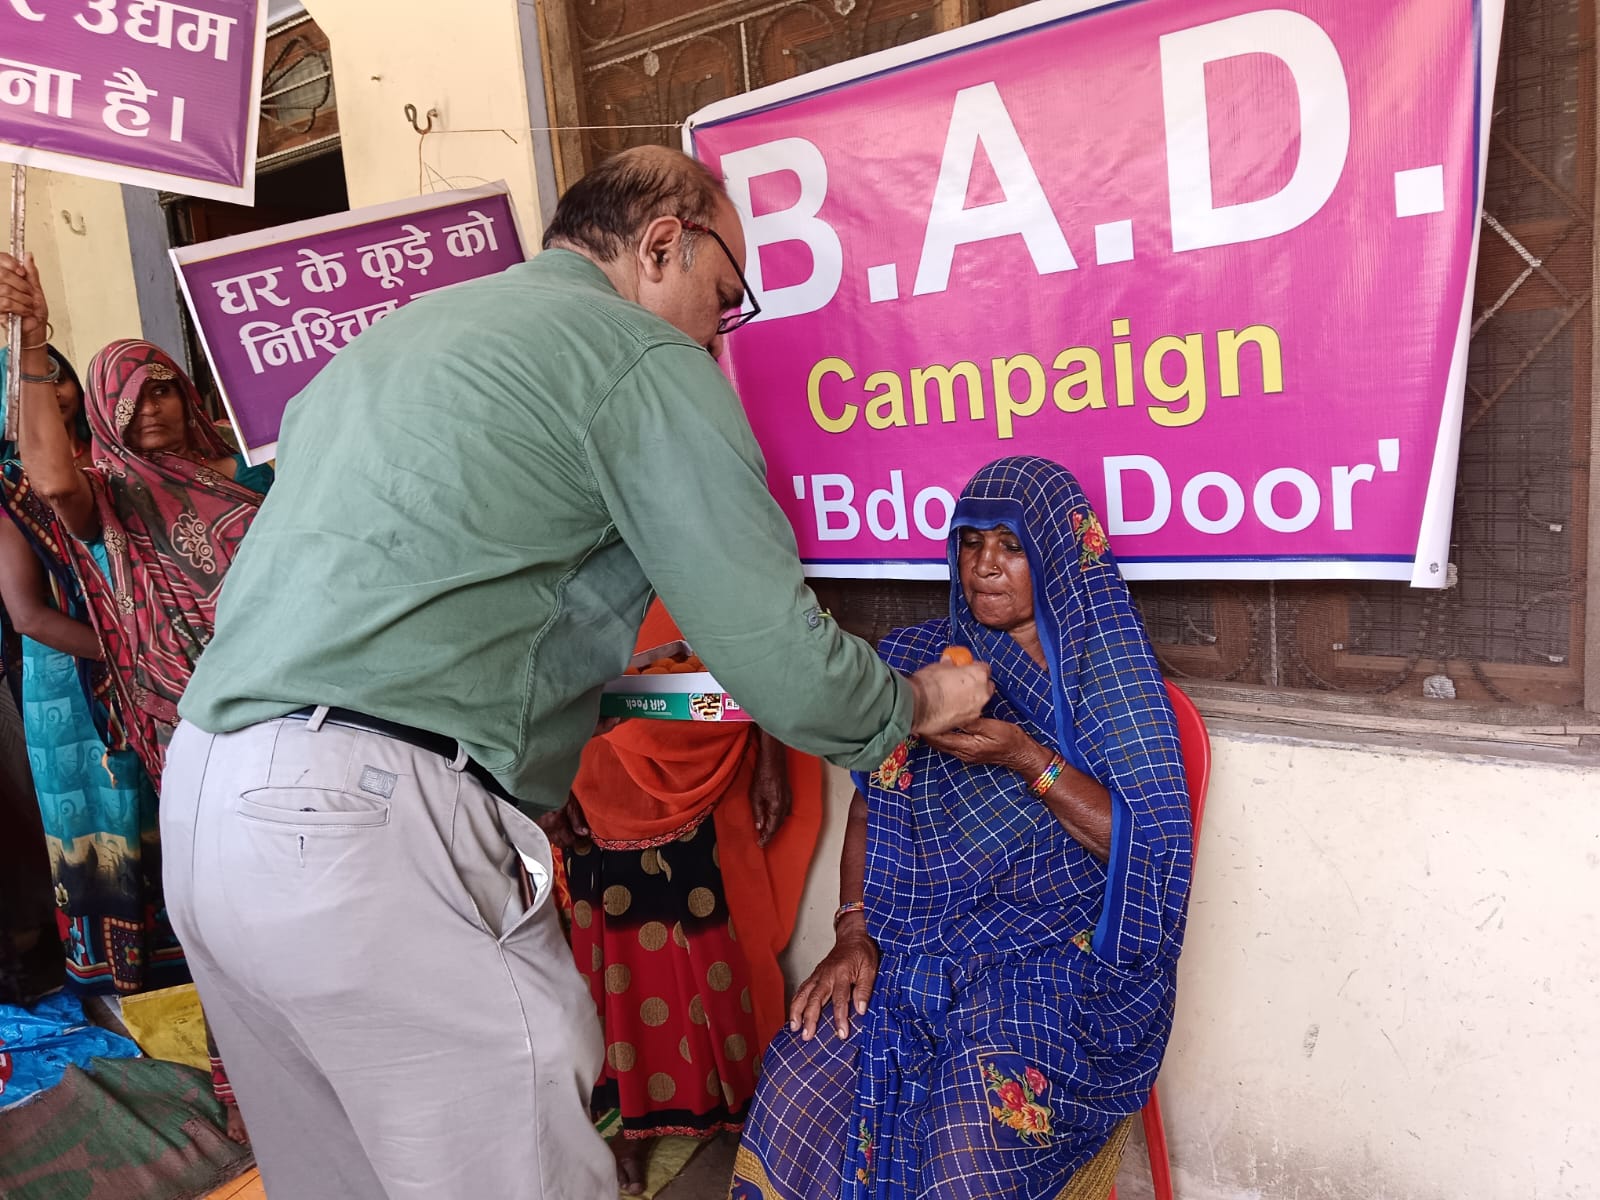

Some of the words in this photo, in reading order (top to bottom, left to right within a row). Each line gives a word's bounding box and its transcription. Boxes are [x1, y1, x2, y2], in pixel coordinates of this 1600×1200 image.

[719, 9, 1445, 323] B.A.D.
[211, 266, 290, 316] घर
[296, 249, 348, 293] के
[356, 225, 434, 289] कूड़े
[442, 211, 499, 258] को
[806, 319, 1285, 440] Campaign
[1102, 438, 1402, 538] Door'
